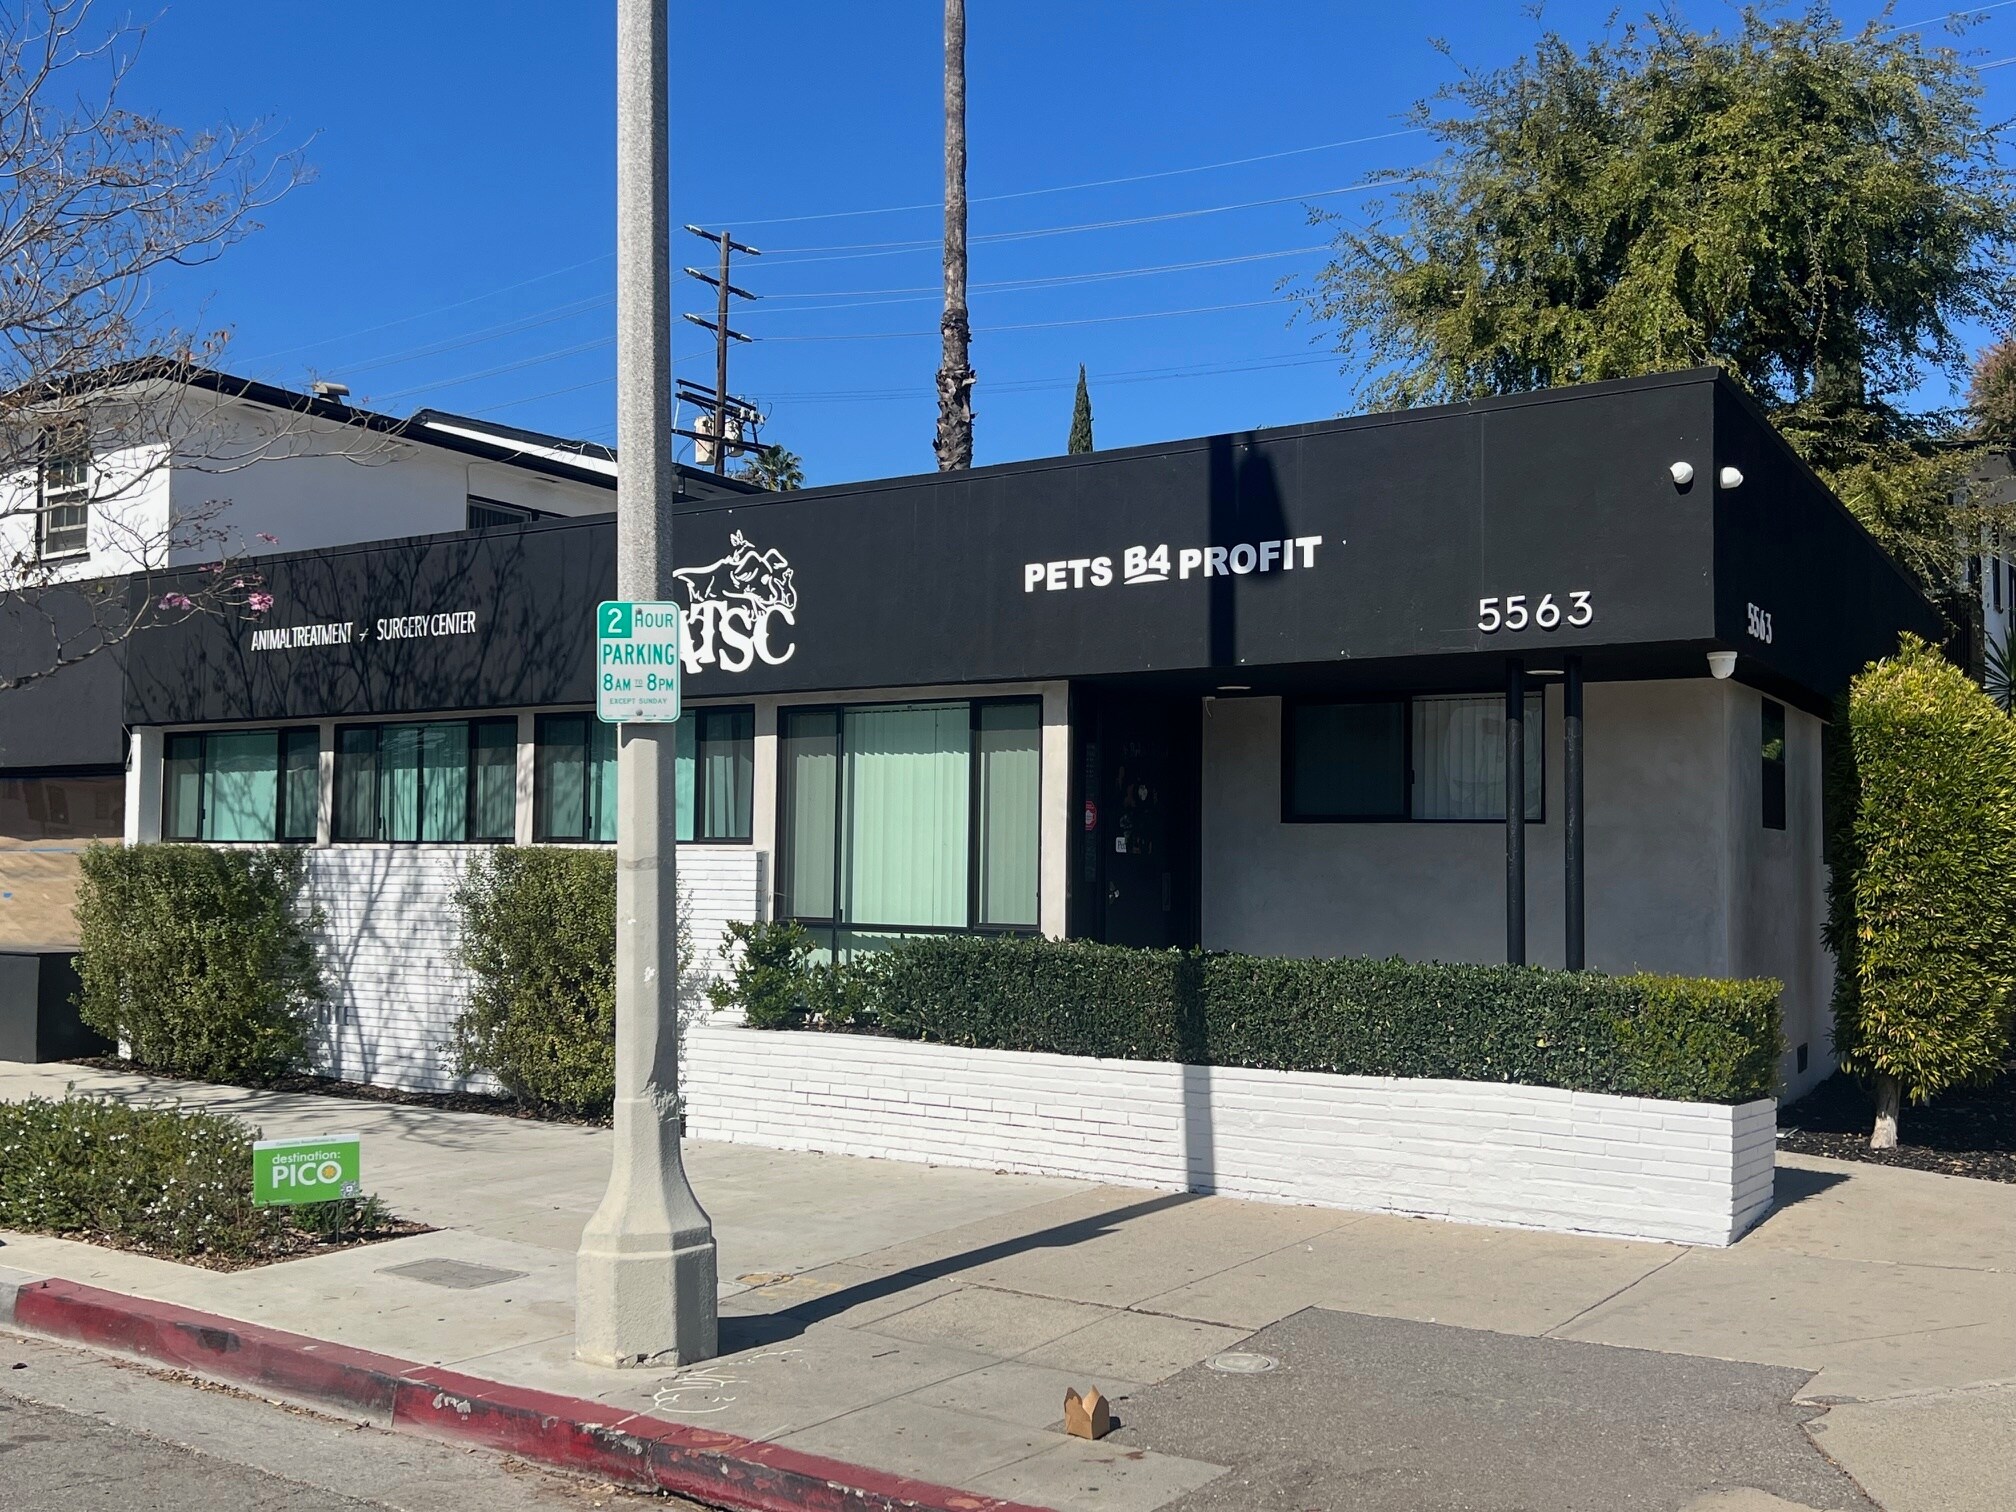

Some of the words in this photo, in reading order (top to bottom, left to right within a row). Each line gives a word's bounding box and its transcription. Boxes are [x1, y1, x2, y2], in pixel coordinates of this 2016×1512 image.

[1024, 556, 1113, 593] PETS
[1123, 544, 1171, 581] B4
[1179, 535, 1322, 580] PROFIT
[607, 608, 623, 634] 2
[635, 613, 674, 628] HOUR
[1477, 590, 1593, 632] 5563
[1748, 602, 1772, 644] 5563
[251, 627, 292, 651] ANIMAL
[291, 622, 353, 648] TREATMENT
[376, 615, 430, 641] SURGERY
[430, 611, 476, 637] CENTER
[603, 643, 675, 665] PARKING
[603, 673, 631, 691] 8AM
[647, 673, 674, 691] 8PM
[272, 1150, 341, 1164] destination:
[272, 1160, 342, 1188] PICO
